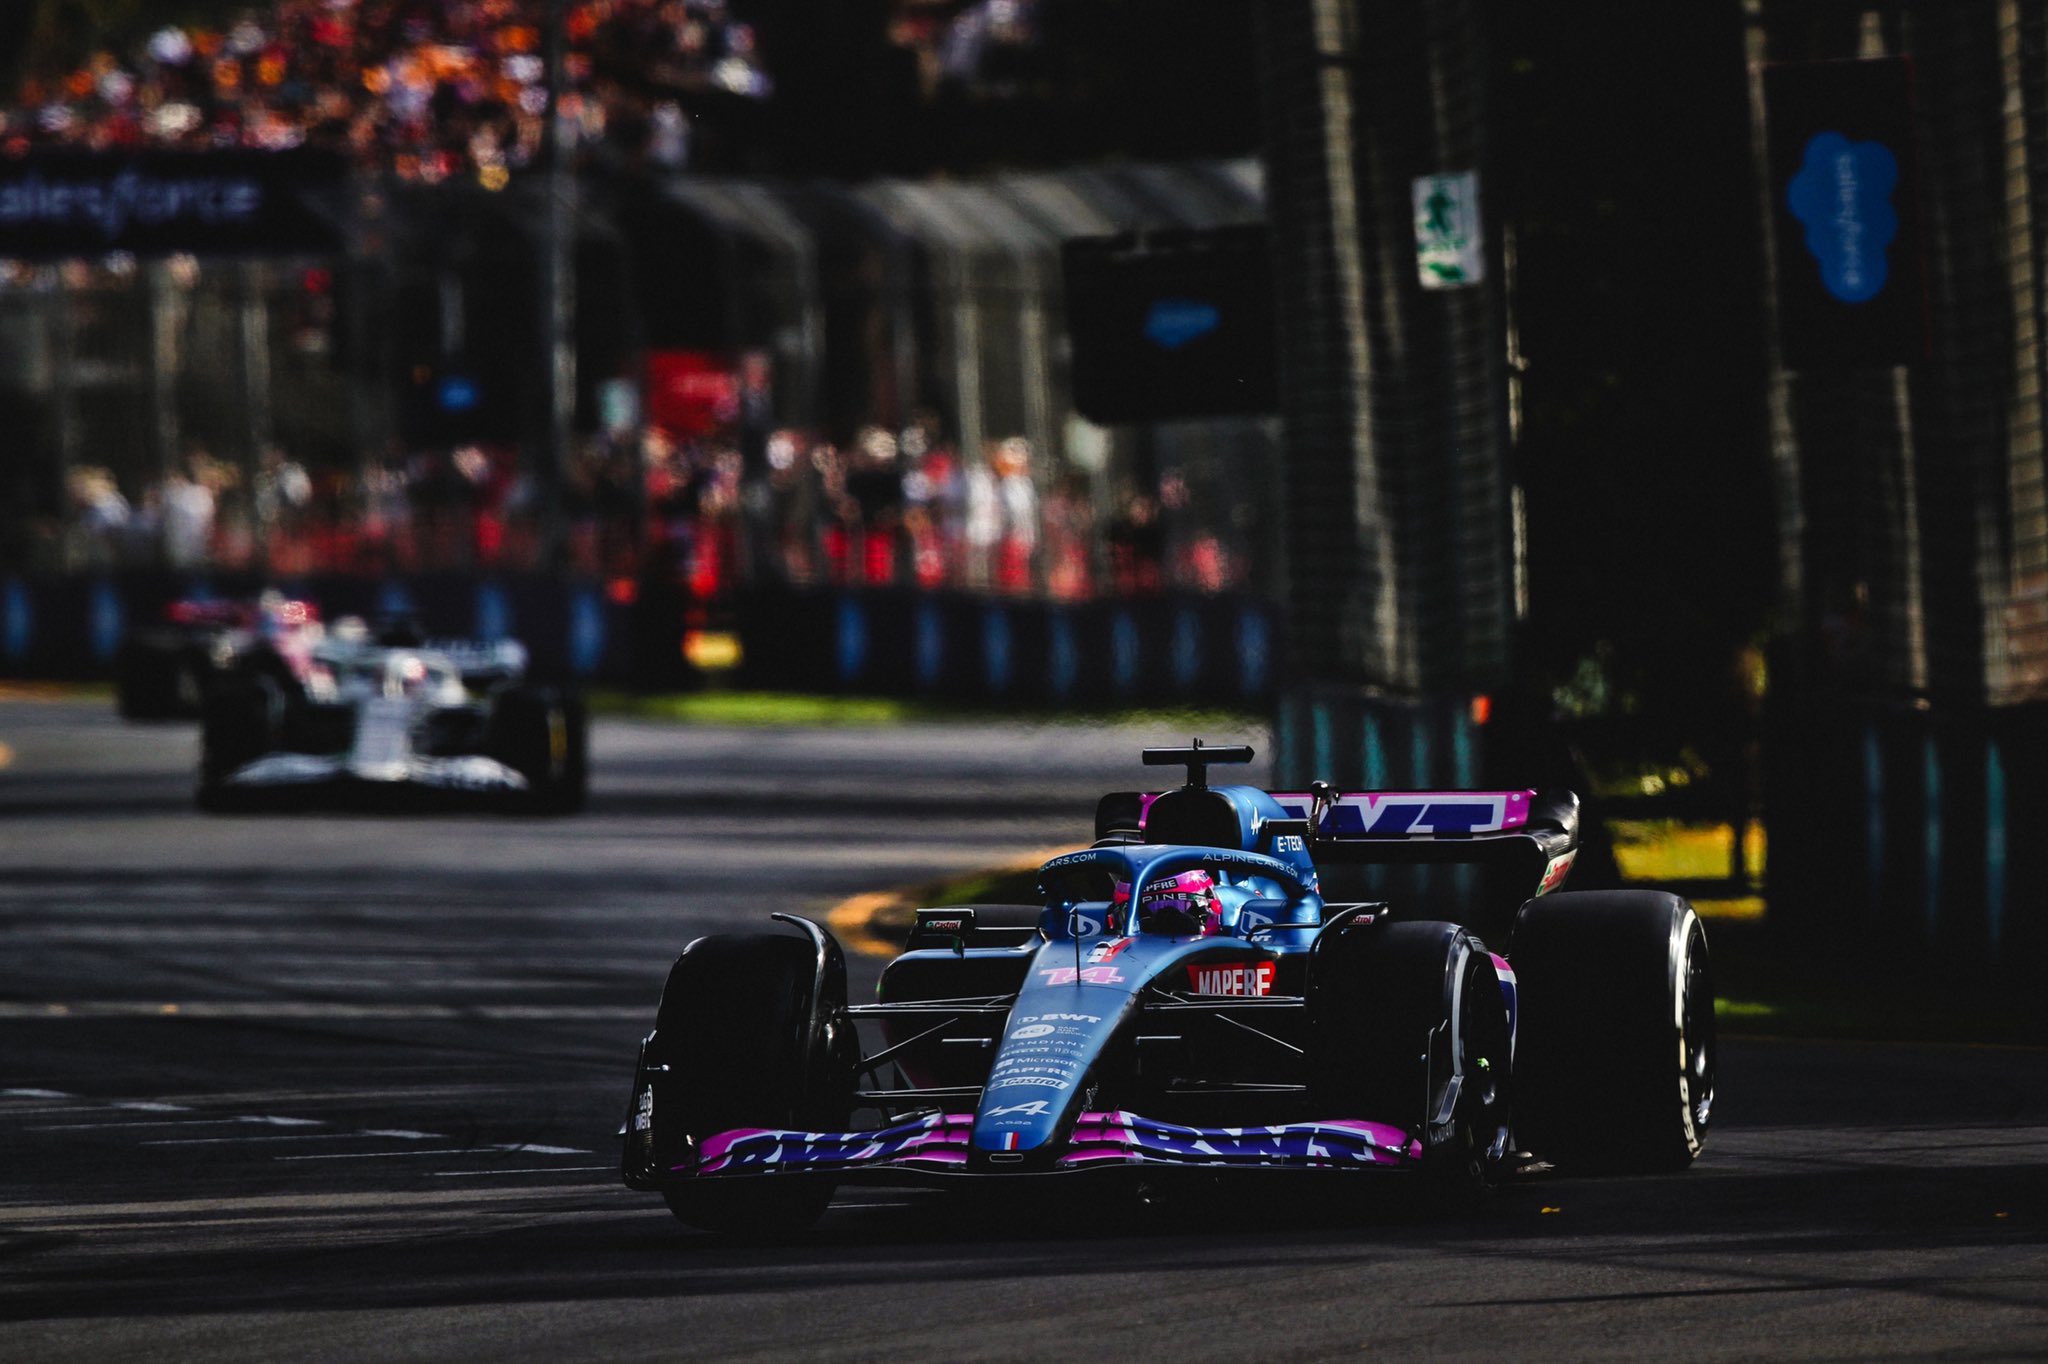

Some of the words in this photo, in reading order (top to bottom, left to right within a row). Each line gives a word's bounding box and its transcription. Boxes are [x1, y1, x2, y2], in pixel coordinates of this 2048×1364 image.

[1276, 834, 1304, 853] E-TECH
[1039, 966, 1126, 986] 14
[1198, 968, 1271, 996] MAPFRE
[1041, 1013, 1101, 1024] BWT
[1016, 1057, 1079, 1070] Microsoft
[991, 1066, 1074, 1080] MAPFRE
[1006, 1077, 1062, 1087] Castrol
